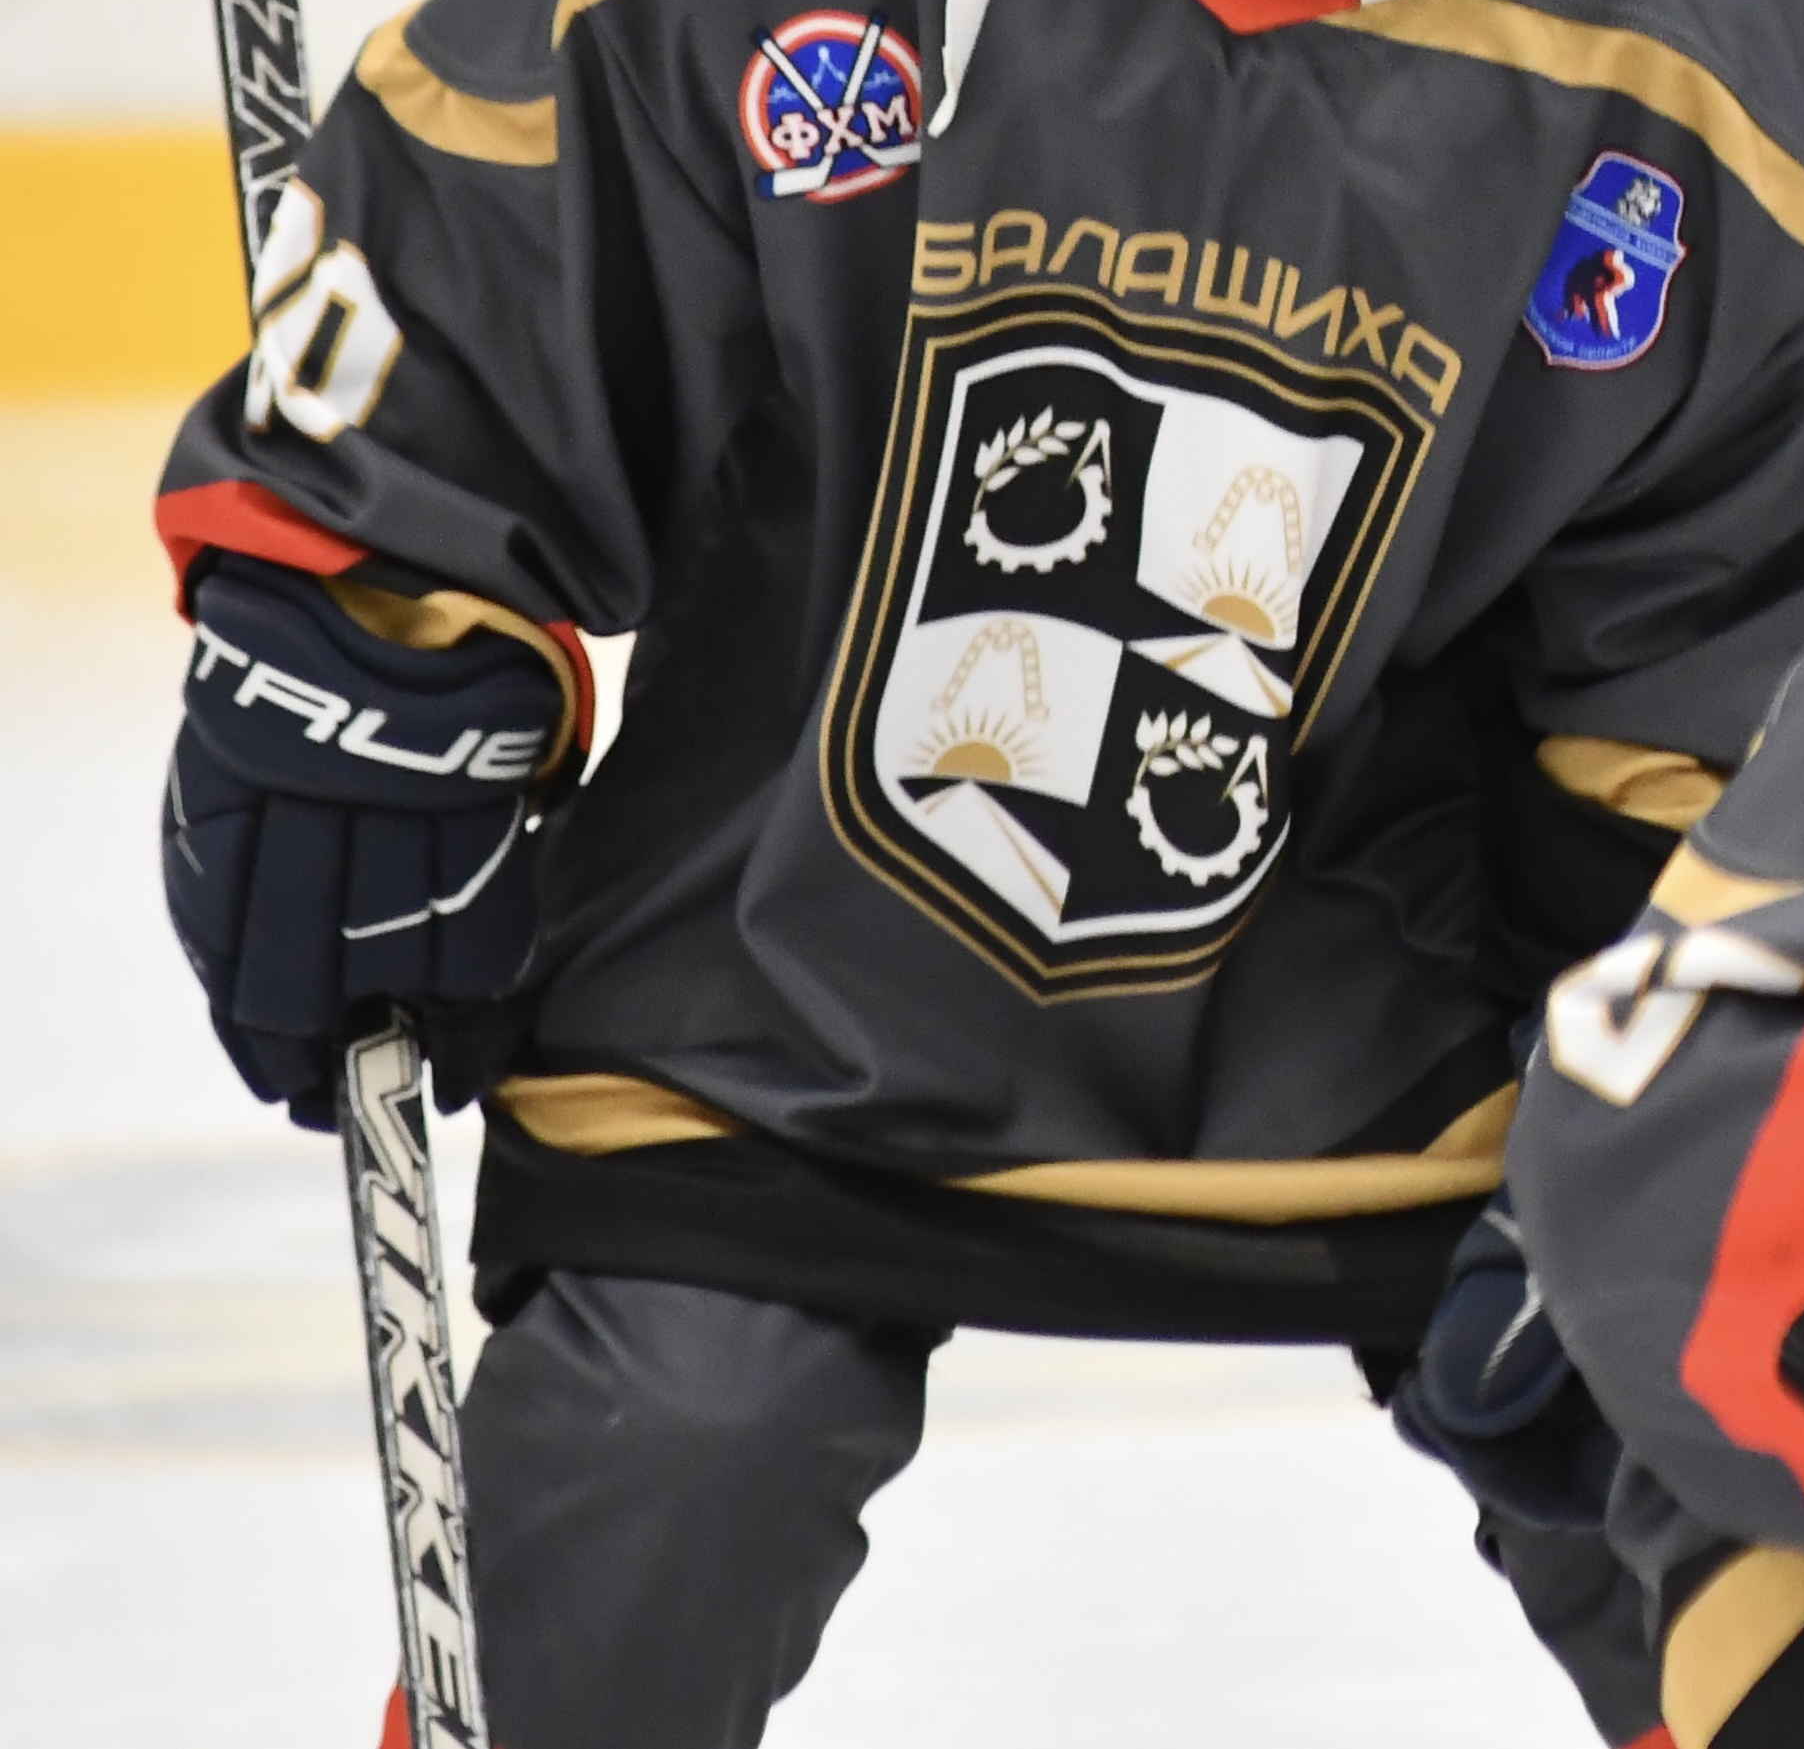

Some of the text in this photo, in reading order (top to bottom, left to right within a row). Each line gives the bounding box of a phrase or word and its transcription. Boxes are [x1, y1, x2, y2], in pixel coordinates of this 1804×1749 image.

[770, 94, 914, 160] ФХМ
[911, 209, 1463, 415] БАЛАШИХА
[195, 622, 545, 780] TRUE
